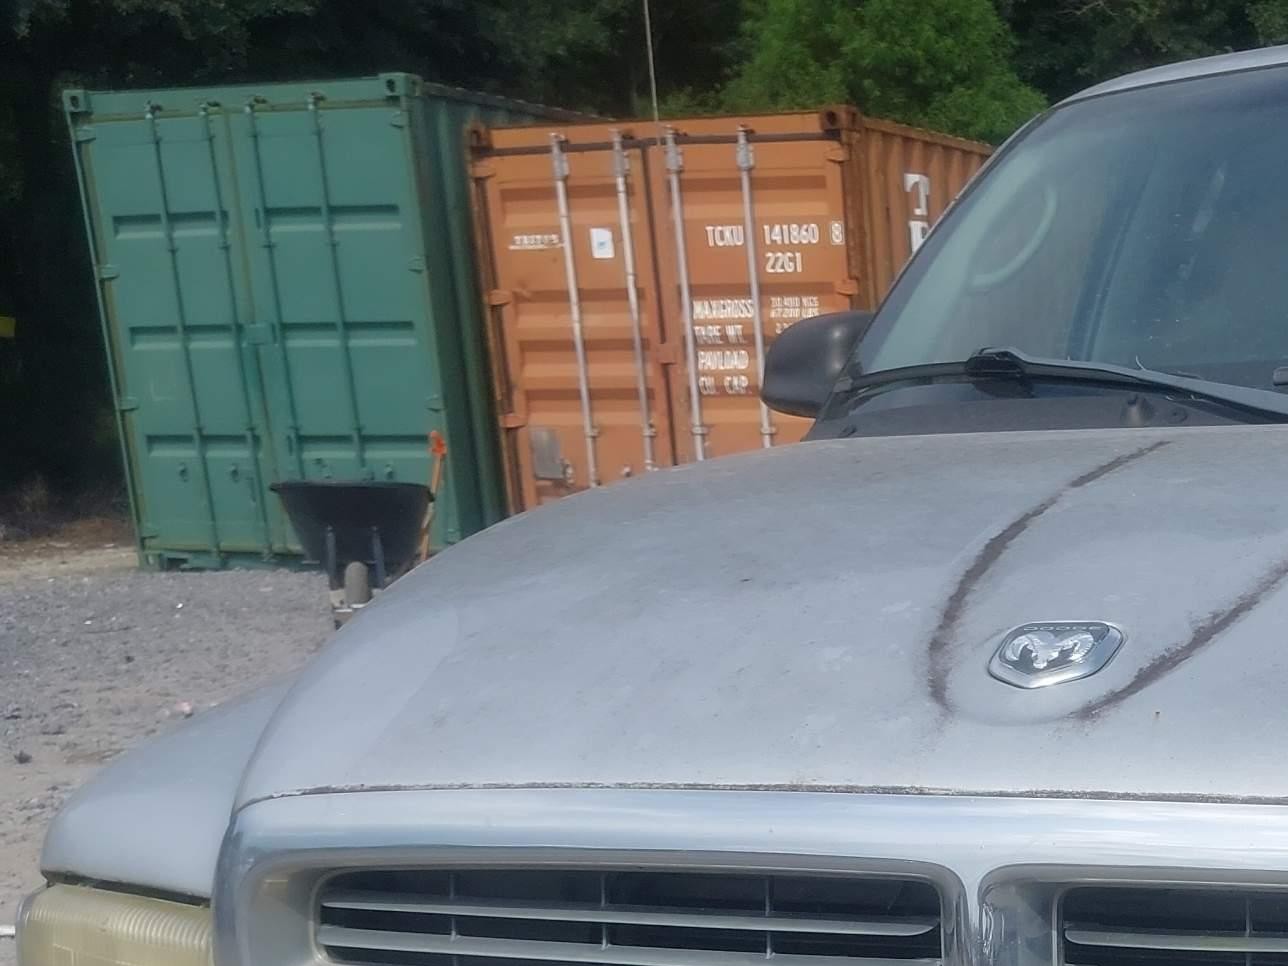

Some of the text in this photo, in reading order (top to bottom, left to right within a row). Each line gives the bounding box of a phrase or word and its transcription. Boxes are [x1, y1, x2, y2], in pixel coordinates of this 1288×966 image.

[705, 222, 845, 247] TCKU 141860 8
